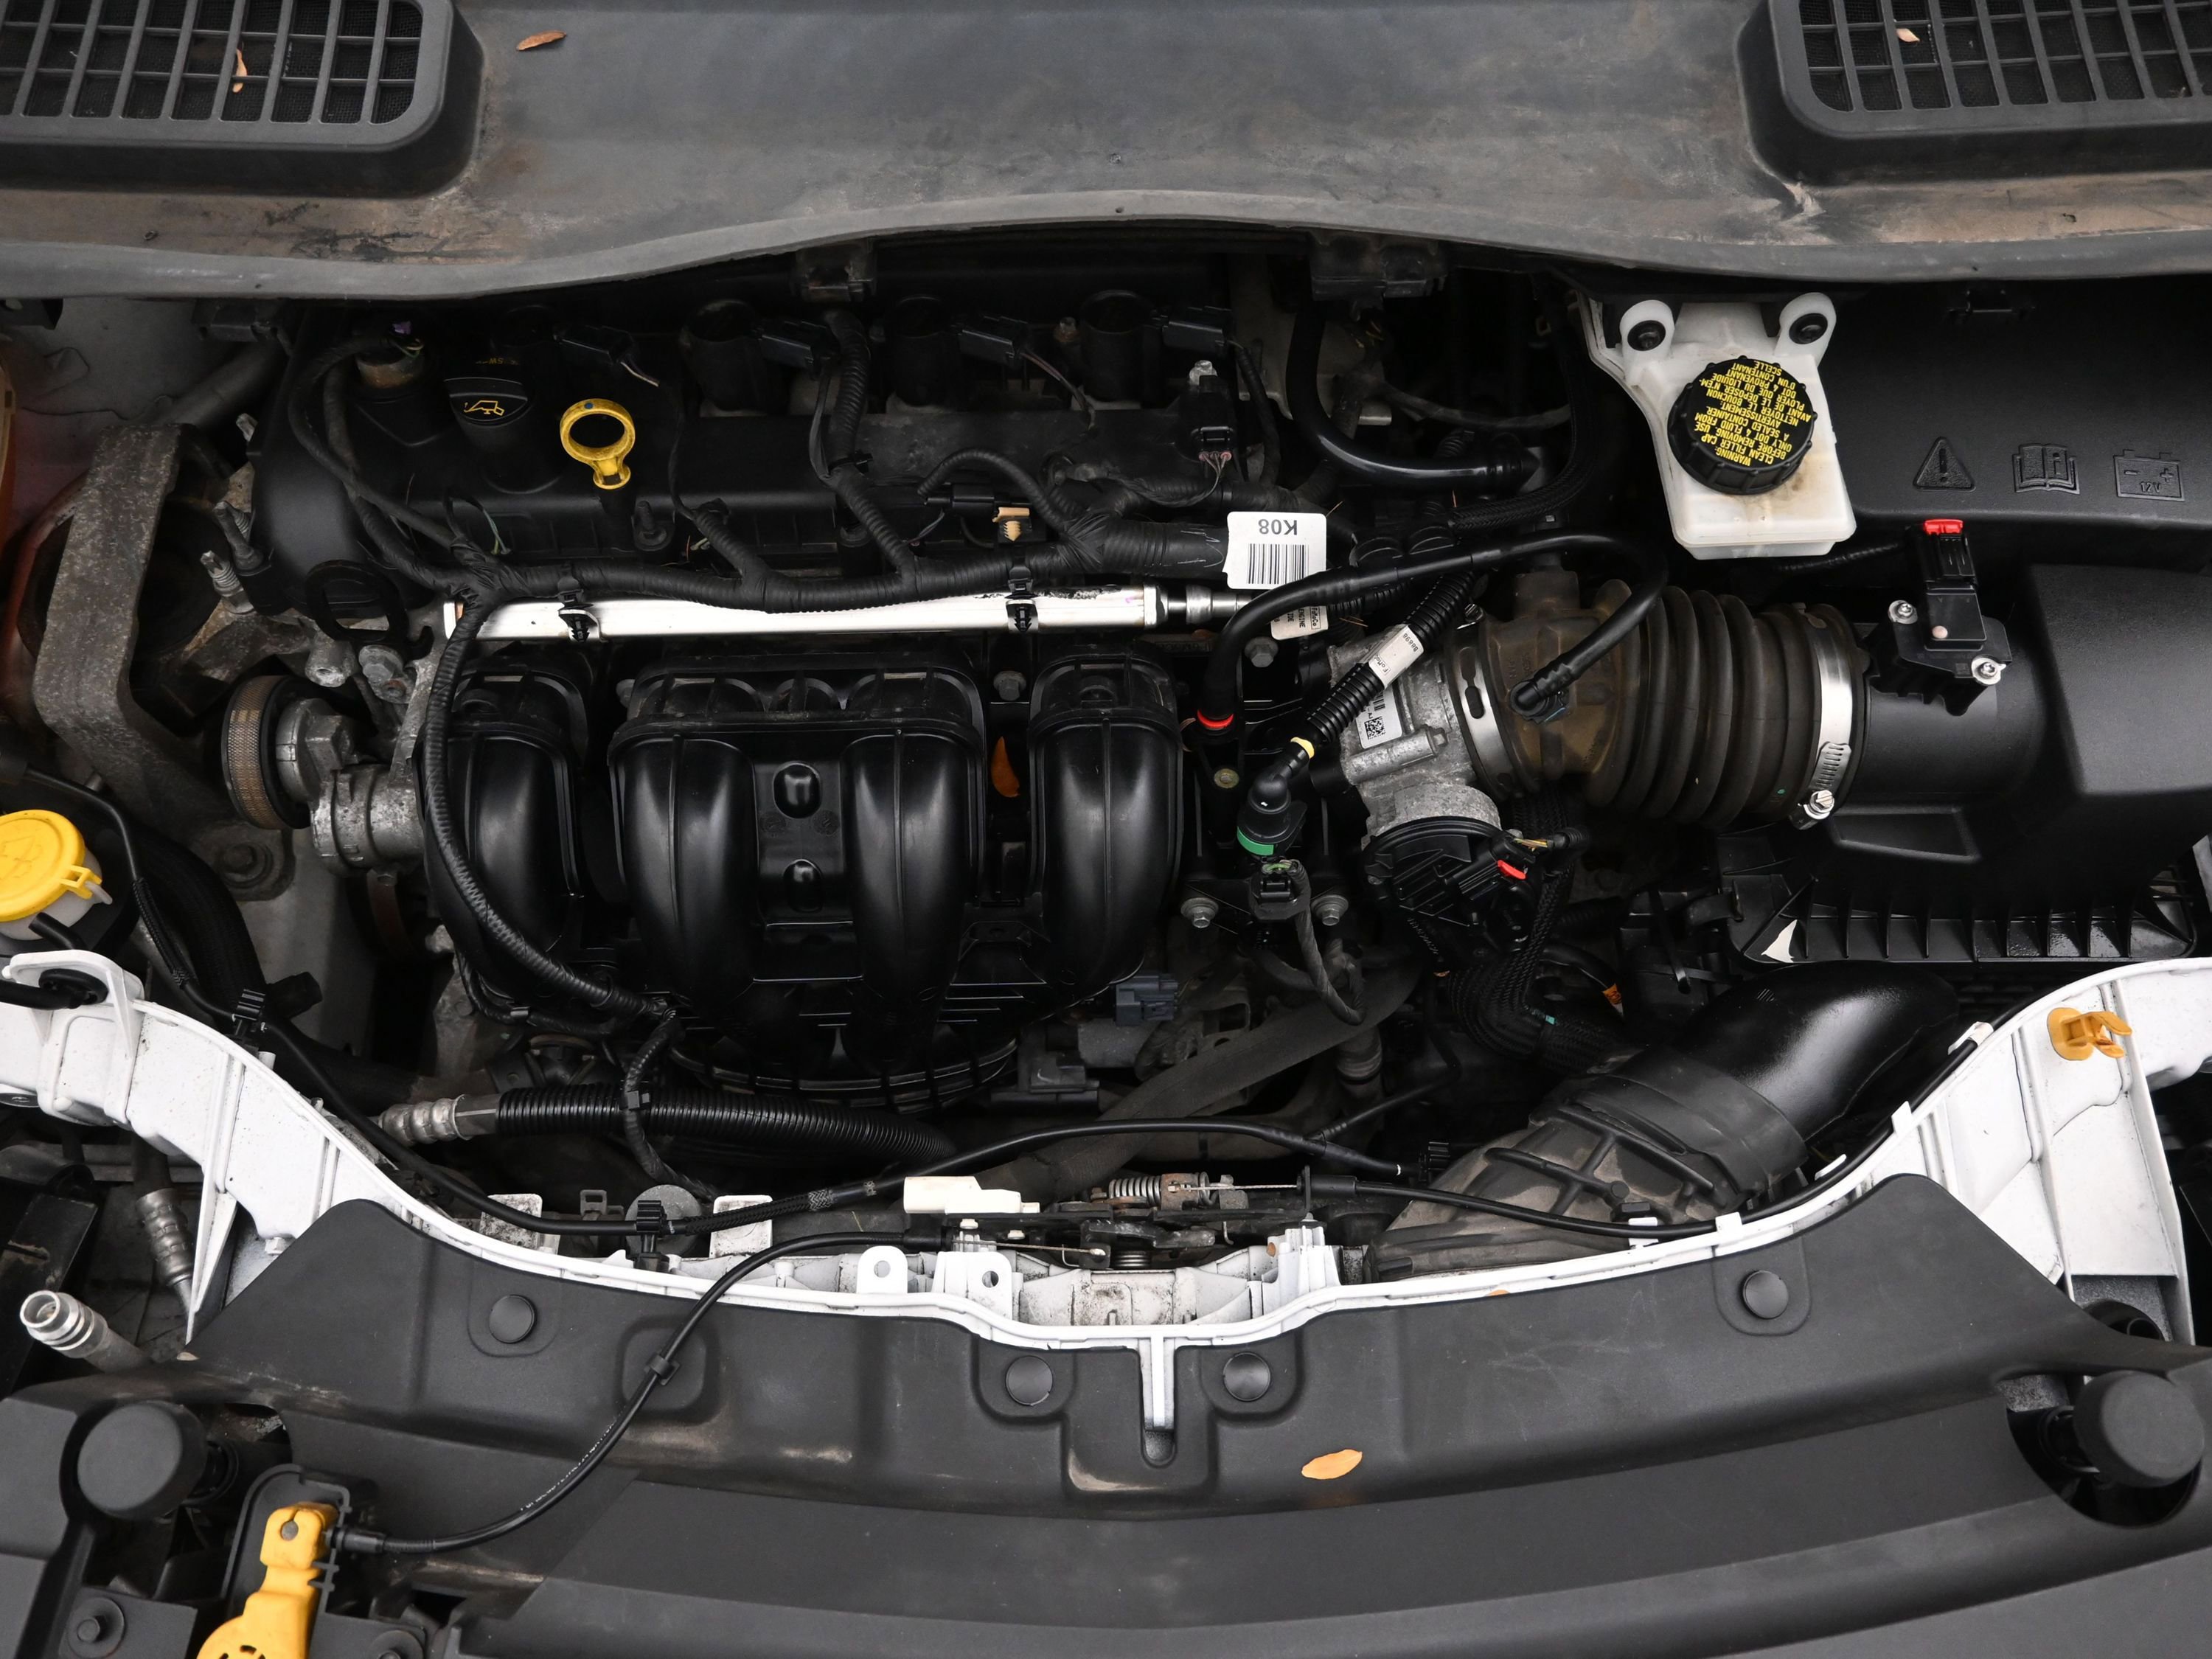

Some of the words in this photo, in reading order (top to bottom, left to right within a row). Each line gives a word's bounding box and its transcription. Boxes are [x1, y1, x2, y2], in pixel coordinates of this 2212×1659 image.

[1726, 369, 1770, 389] PROVENANT
[1732, 363, 1775, 382] CONTENANT
[1712, 373, 1741, 386] LIQUIDE
[1778, 378, 1795, 389] D'UN
[1745, 383, 1755, 392] DU
[1759, 388, 1773, 399] QUE
[1782, 389, 1796, 398] DOT
[1706, 389, 1743, 406] BOUCHON
[1761, 397, 1771, 406] LE
[1776, 394, 1805, 411] PLOYER
[1775, 403, 1784, 411] DE
[1694, 412, 1718, 425] FROM
[1706, 406, 1748, 426] CONTAINER.
[1761, 406, 1798, 426] NETTOYER
[1787, 409, 1812, 422] AVANT
[1694, 422, 1711, 432] USE
[1721, 421, 1742, 434] FLUID
[1746, 428, 1751, 437] 4
[1752, 422, 1780, 437] SEALED
[1701, 434, 1717, 445] CAP
[1715, 426, 1755, 448] REMOVING.
[1755, 432, 1770, 442] DOT
[1784, 433, 1790, 441] A
[1720, 442, 1746, 454] FILLER
[1758, 446, 1787, 459] BEFORE
[1773, 440, 1792, 452] ONLY
[1714, 446, 1751, 466] WARNING:
[1749, 451, 1774, 465] CLEAN
[2140, 481, 2160, 493] 12V
[1258, 519, 1298, 535] K08
[1298, 608, 1306, 627] ENGINE
